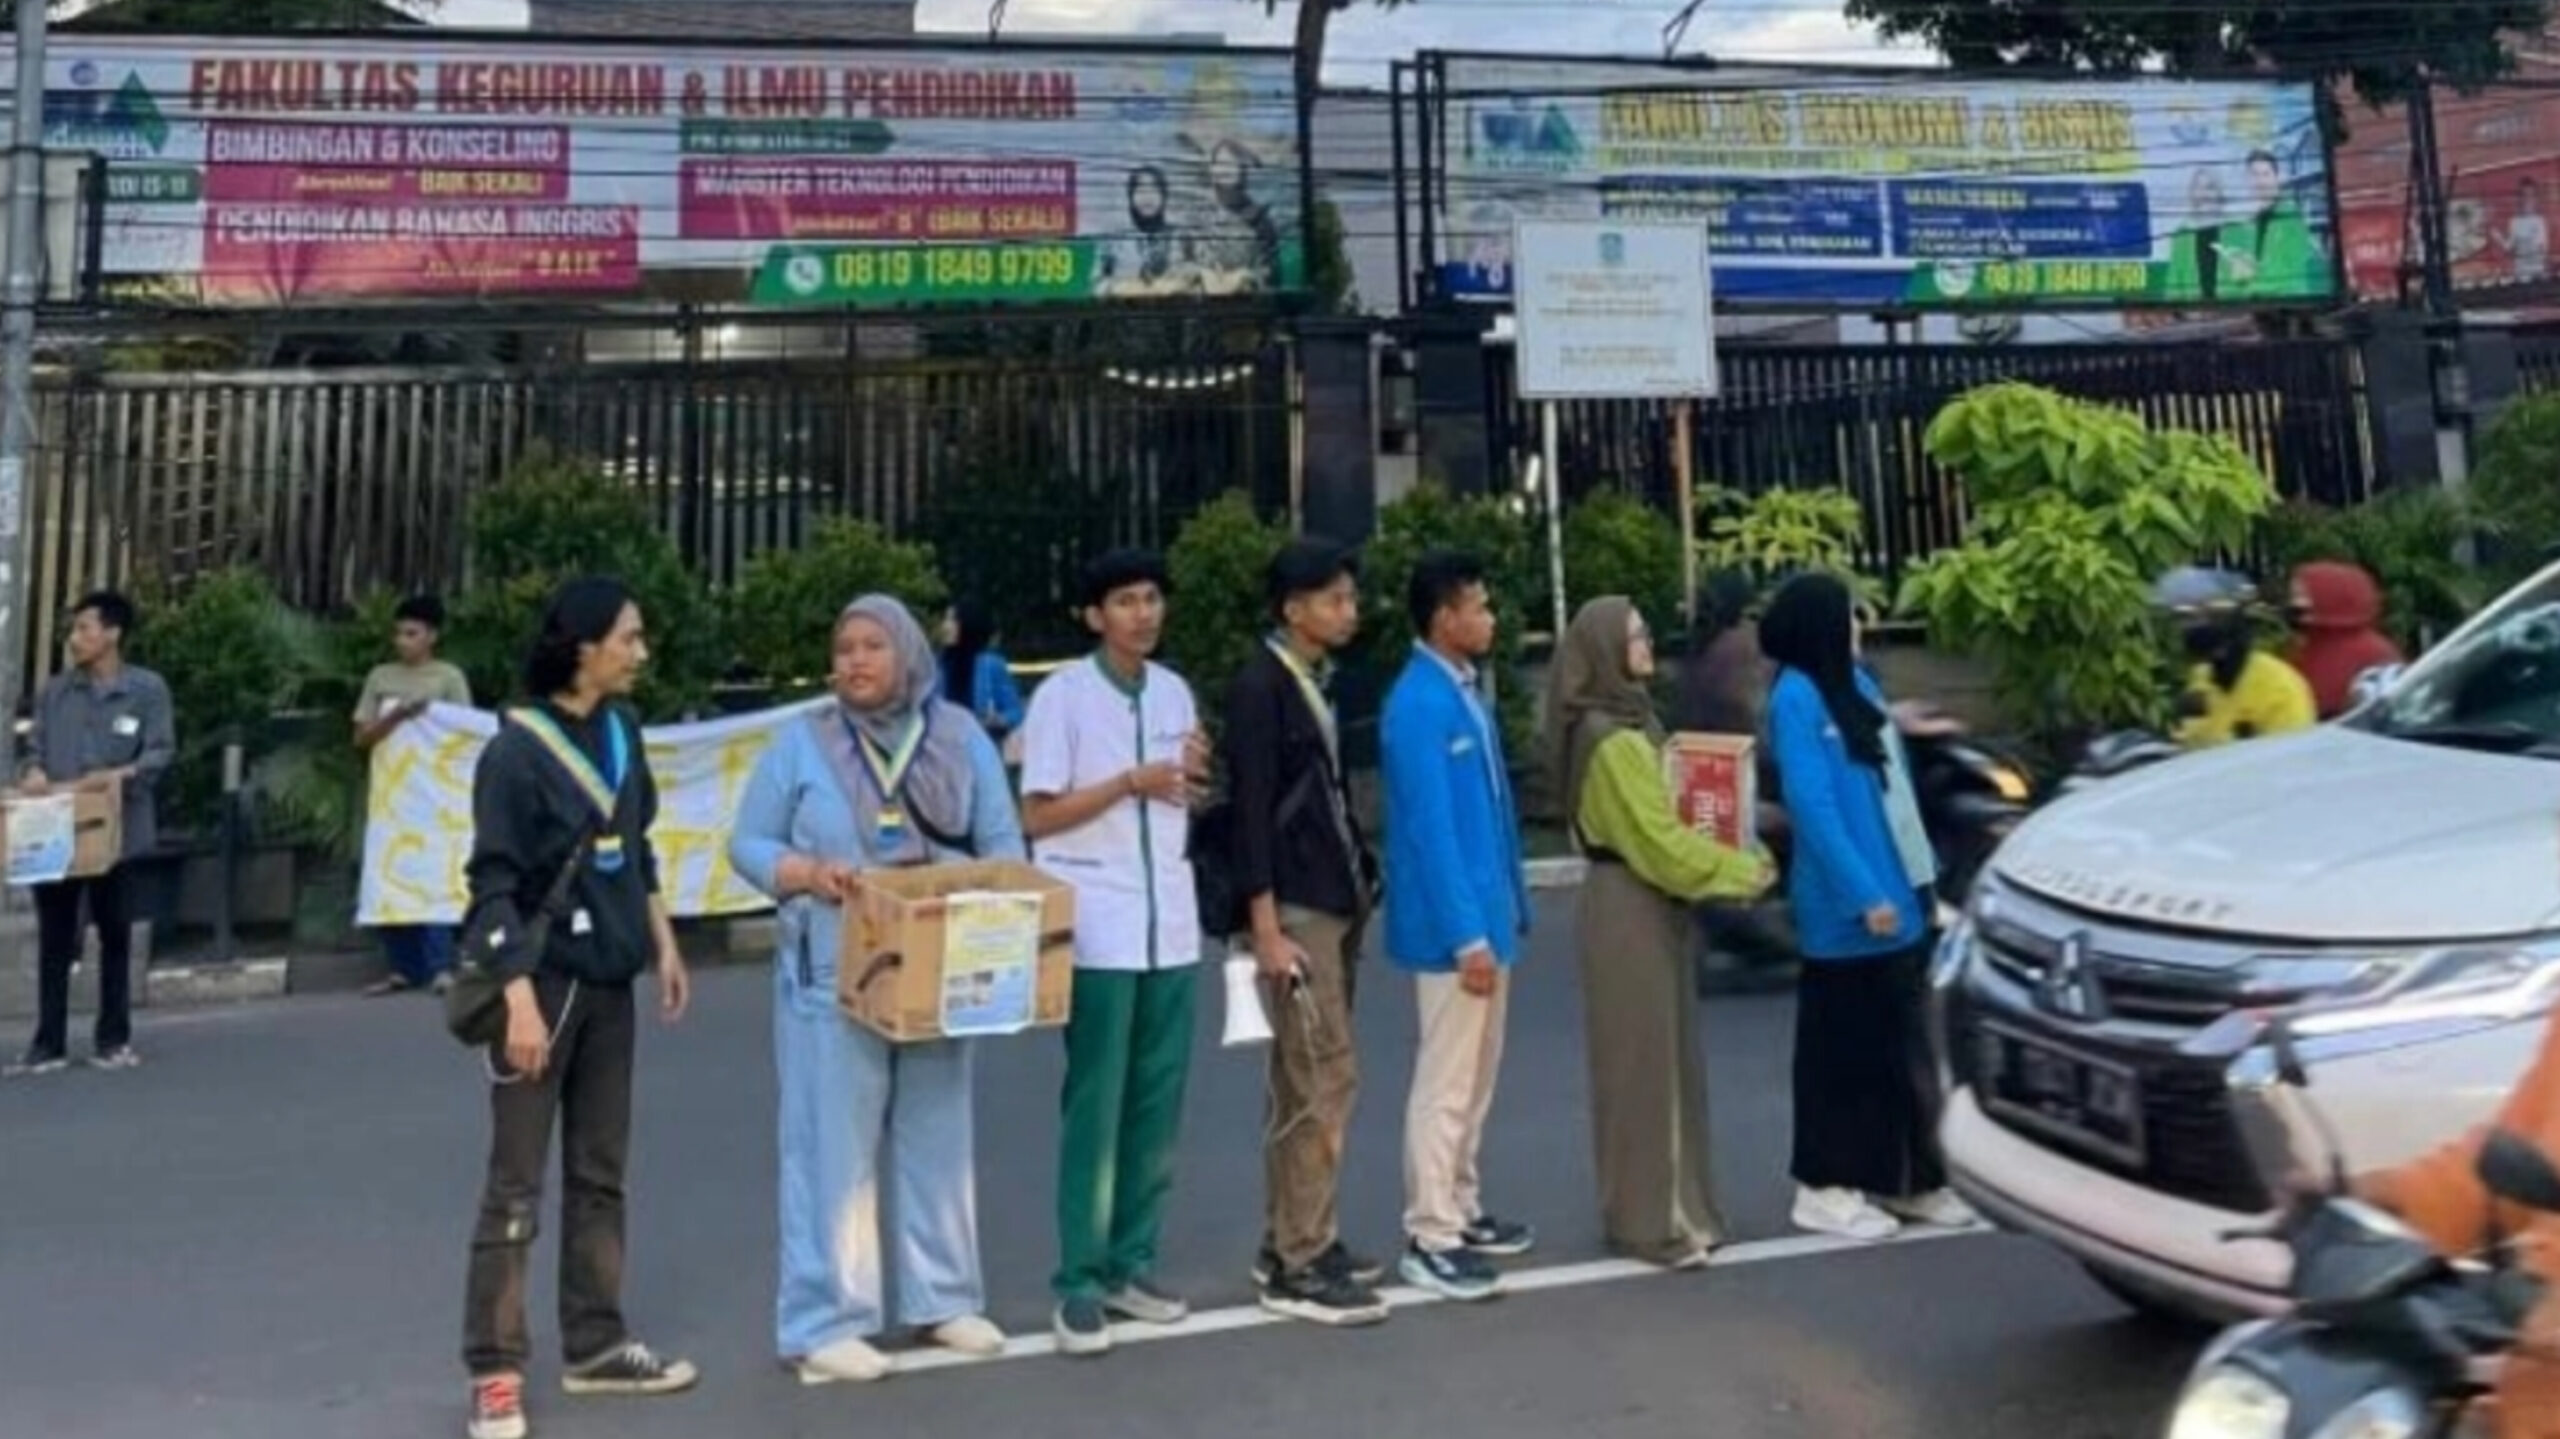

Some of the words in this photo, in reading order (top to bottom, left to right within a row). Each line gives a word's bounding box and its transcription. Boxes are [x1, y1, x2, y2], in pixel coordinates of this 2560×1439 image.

[189, 59, 419, 112] FAKULTAS
[436, 62, 664, 115] KEGURUAN
[680, 72, 707, 116] &
[723, 65, 827, 117] ILMU
[843, 69, 1076, 118] PENDIDIKAN
[1798, 95, 1970, 149] EKONOMI
[2018, 101, 2134, 152] BISNIS
[211, 127, 374, 163] BIMBINGAN
[405, 129, 561, 163] KONSELING
[815, 166, 934, 194] TEKNOLOGI
[940, 167, 1066, 195] PENDIDIKAN
[217, 206, 388, 242] PENDIDIKAN
[396, 206, 508, 241] BAHASA
[514, 207, 622, 241] INGGRIS
[835, 252, 911, 287] 0819
[923, 250, 992, 286] 1849
[1001, 248, 1073, 285] 9799
